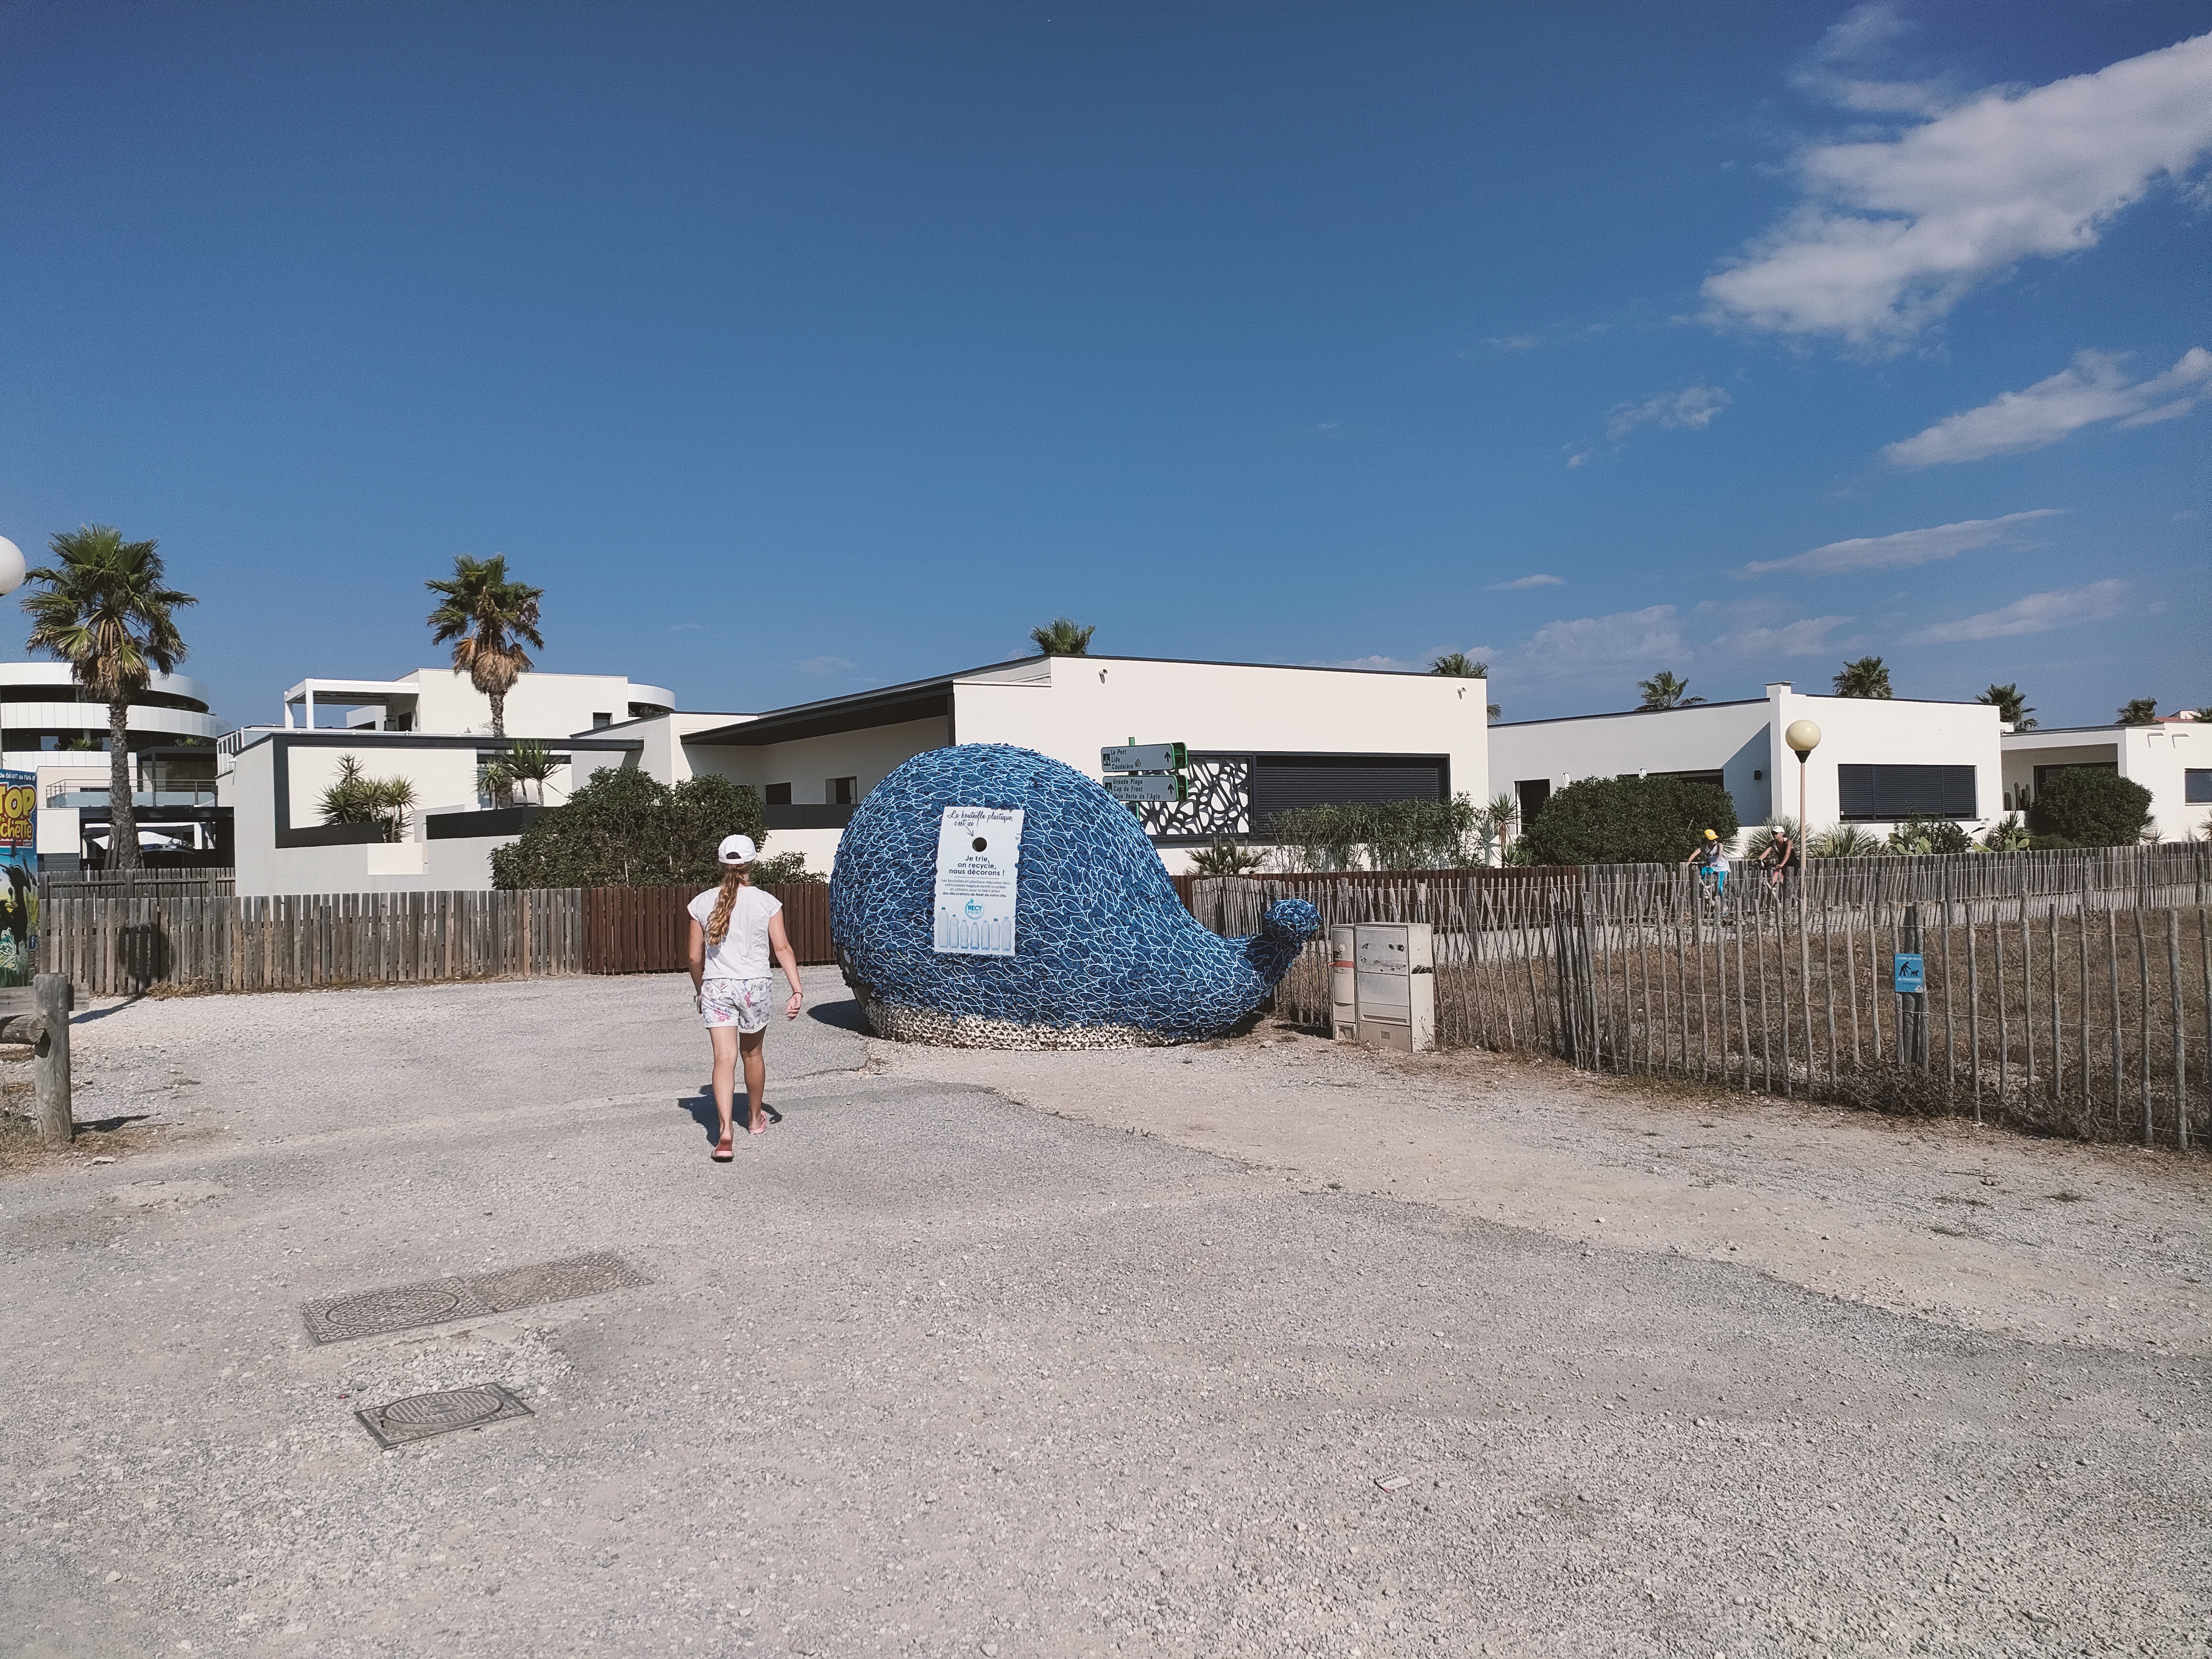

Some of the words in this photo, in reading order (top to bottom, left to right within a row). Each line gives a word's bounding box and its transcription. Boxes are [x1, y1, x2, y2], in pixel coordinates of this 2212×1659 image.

[1147, 793, 1161, 801] l'Agly
[947, 809, 960, 819] La
[961, 810, 986, 819] bouteille
[954, 818, 967, 827] c'est
